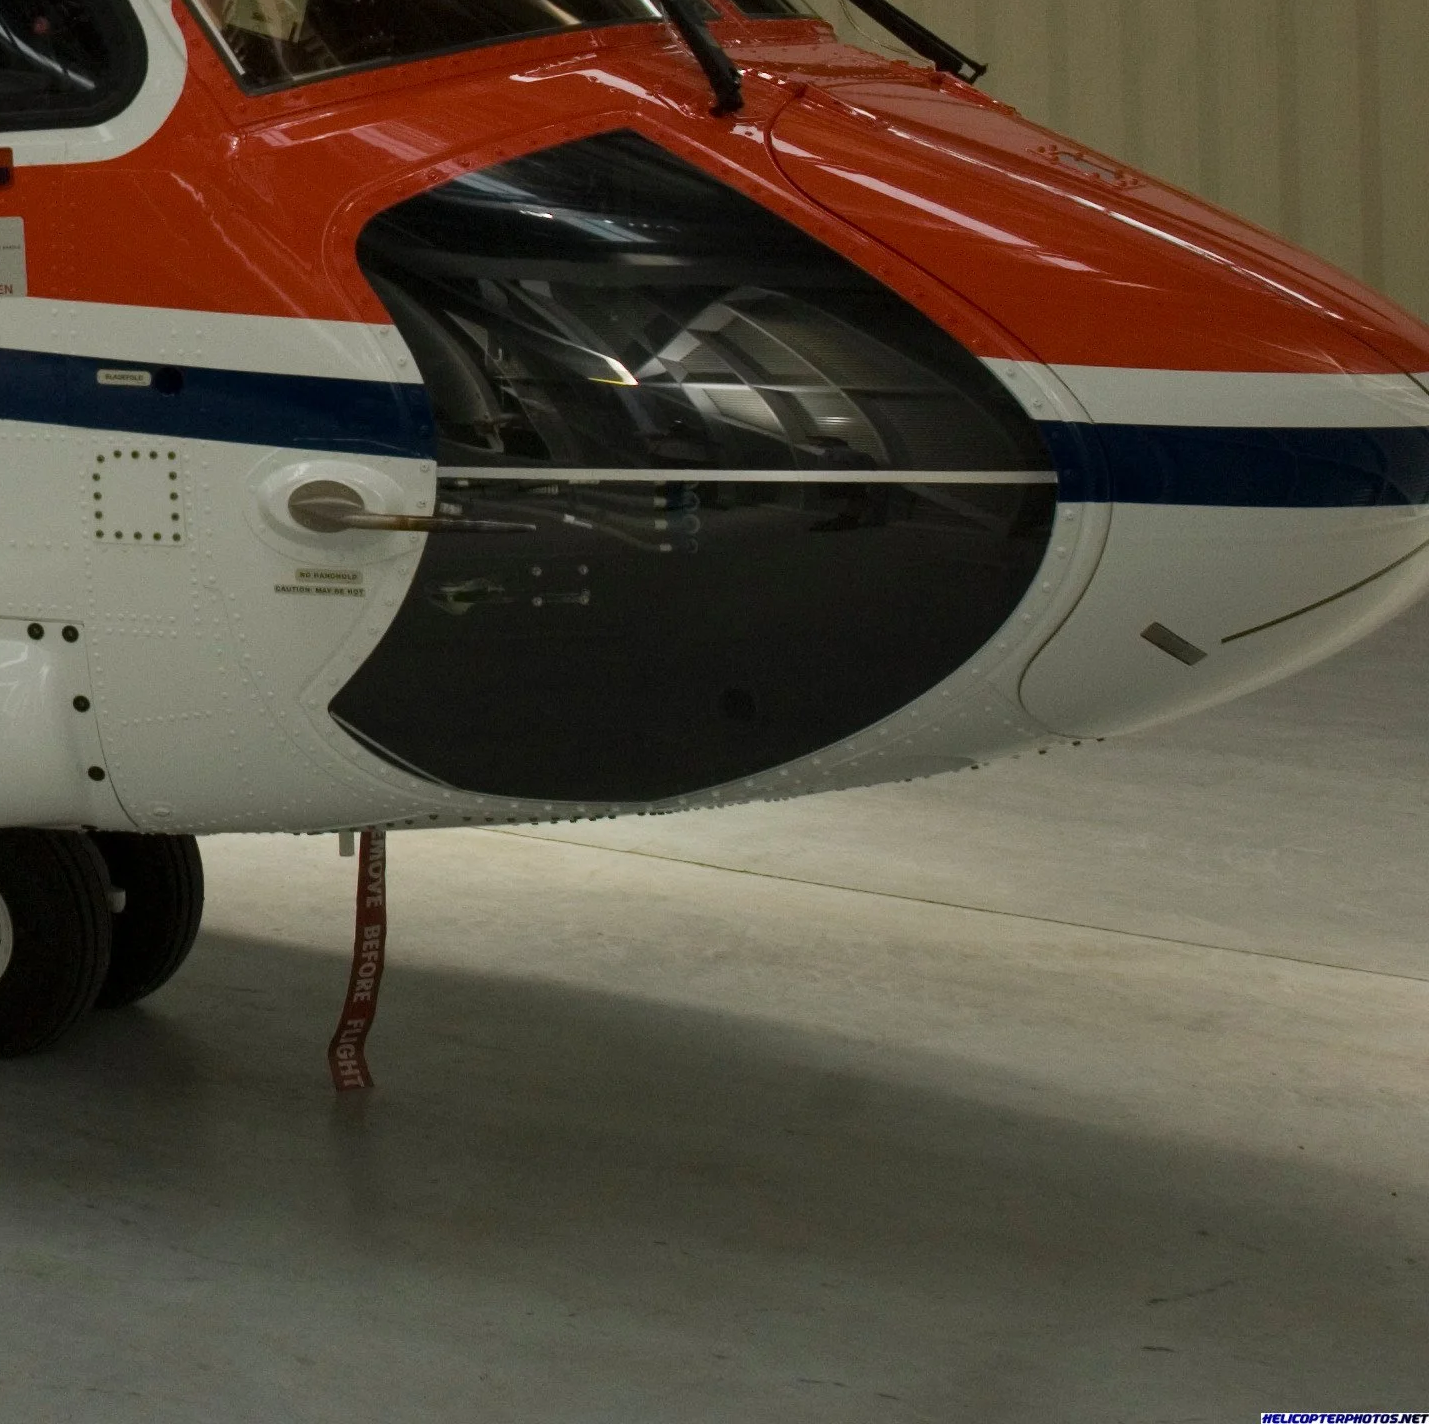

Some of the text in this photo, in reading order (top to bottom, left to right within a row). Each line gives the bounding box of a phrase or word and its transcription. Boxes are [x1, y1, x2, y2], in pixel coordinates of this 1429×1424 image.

[314, 572, 358, 581] HANDHOLD
[347, 588, 364, 596] HOT
[336, 830, 384, 1088] EMOVE BEFORE FLIGHT
